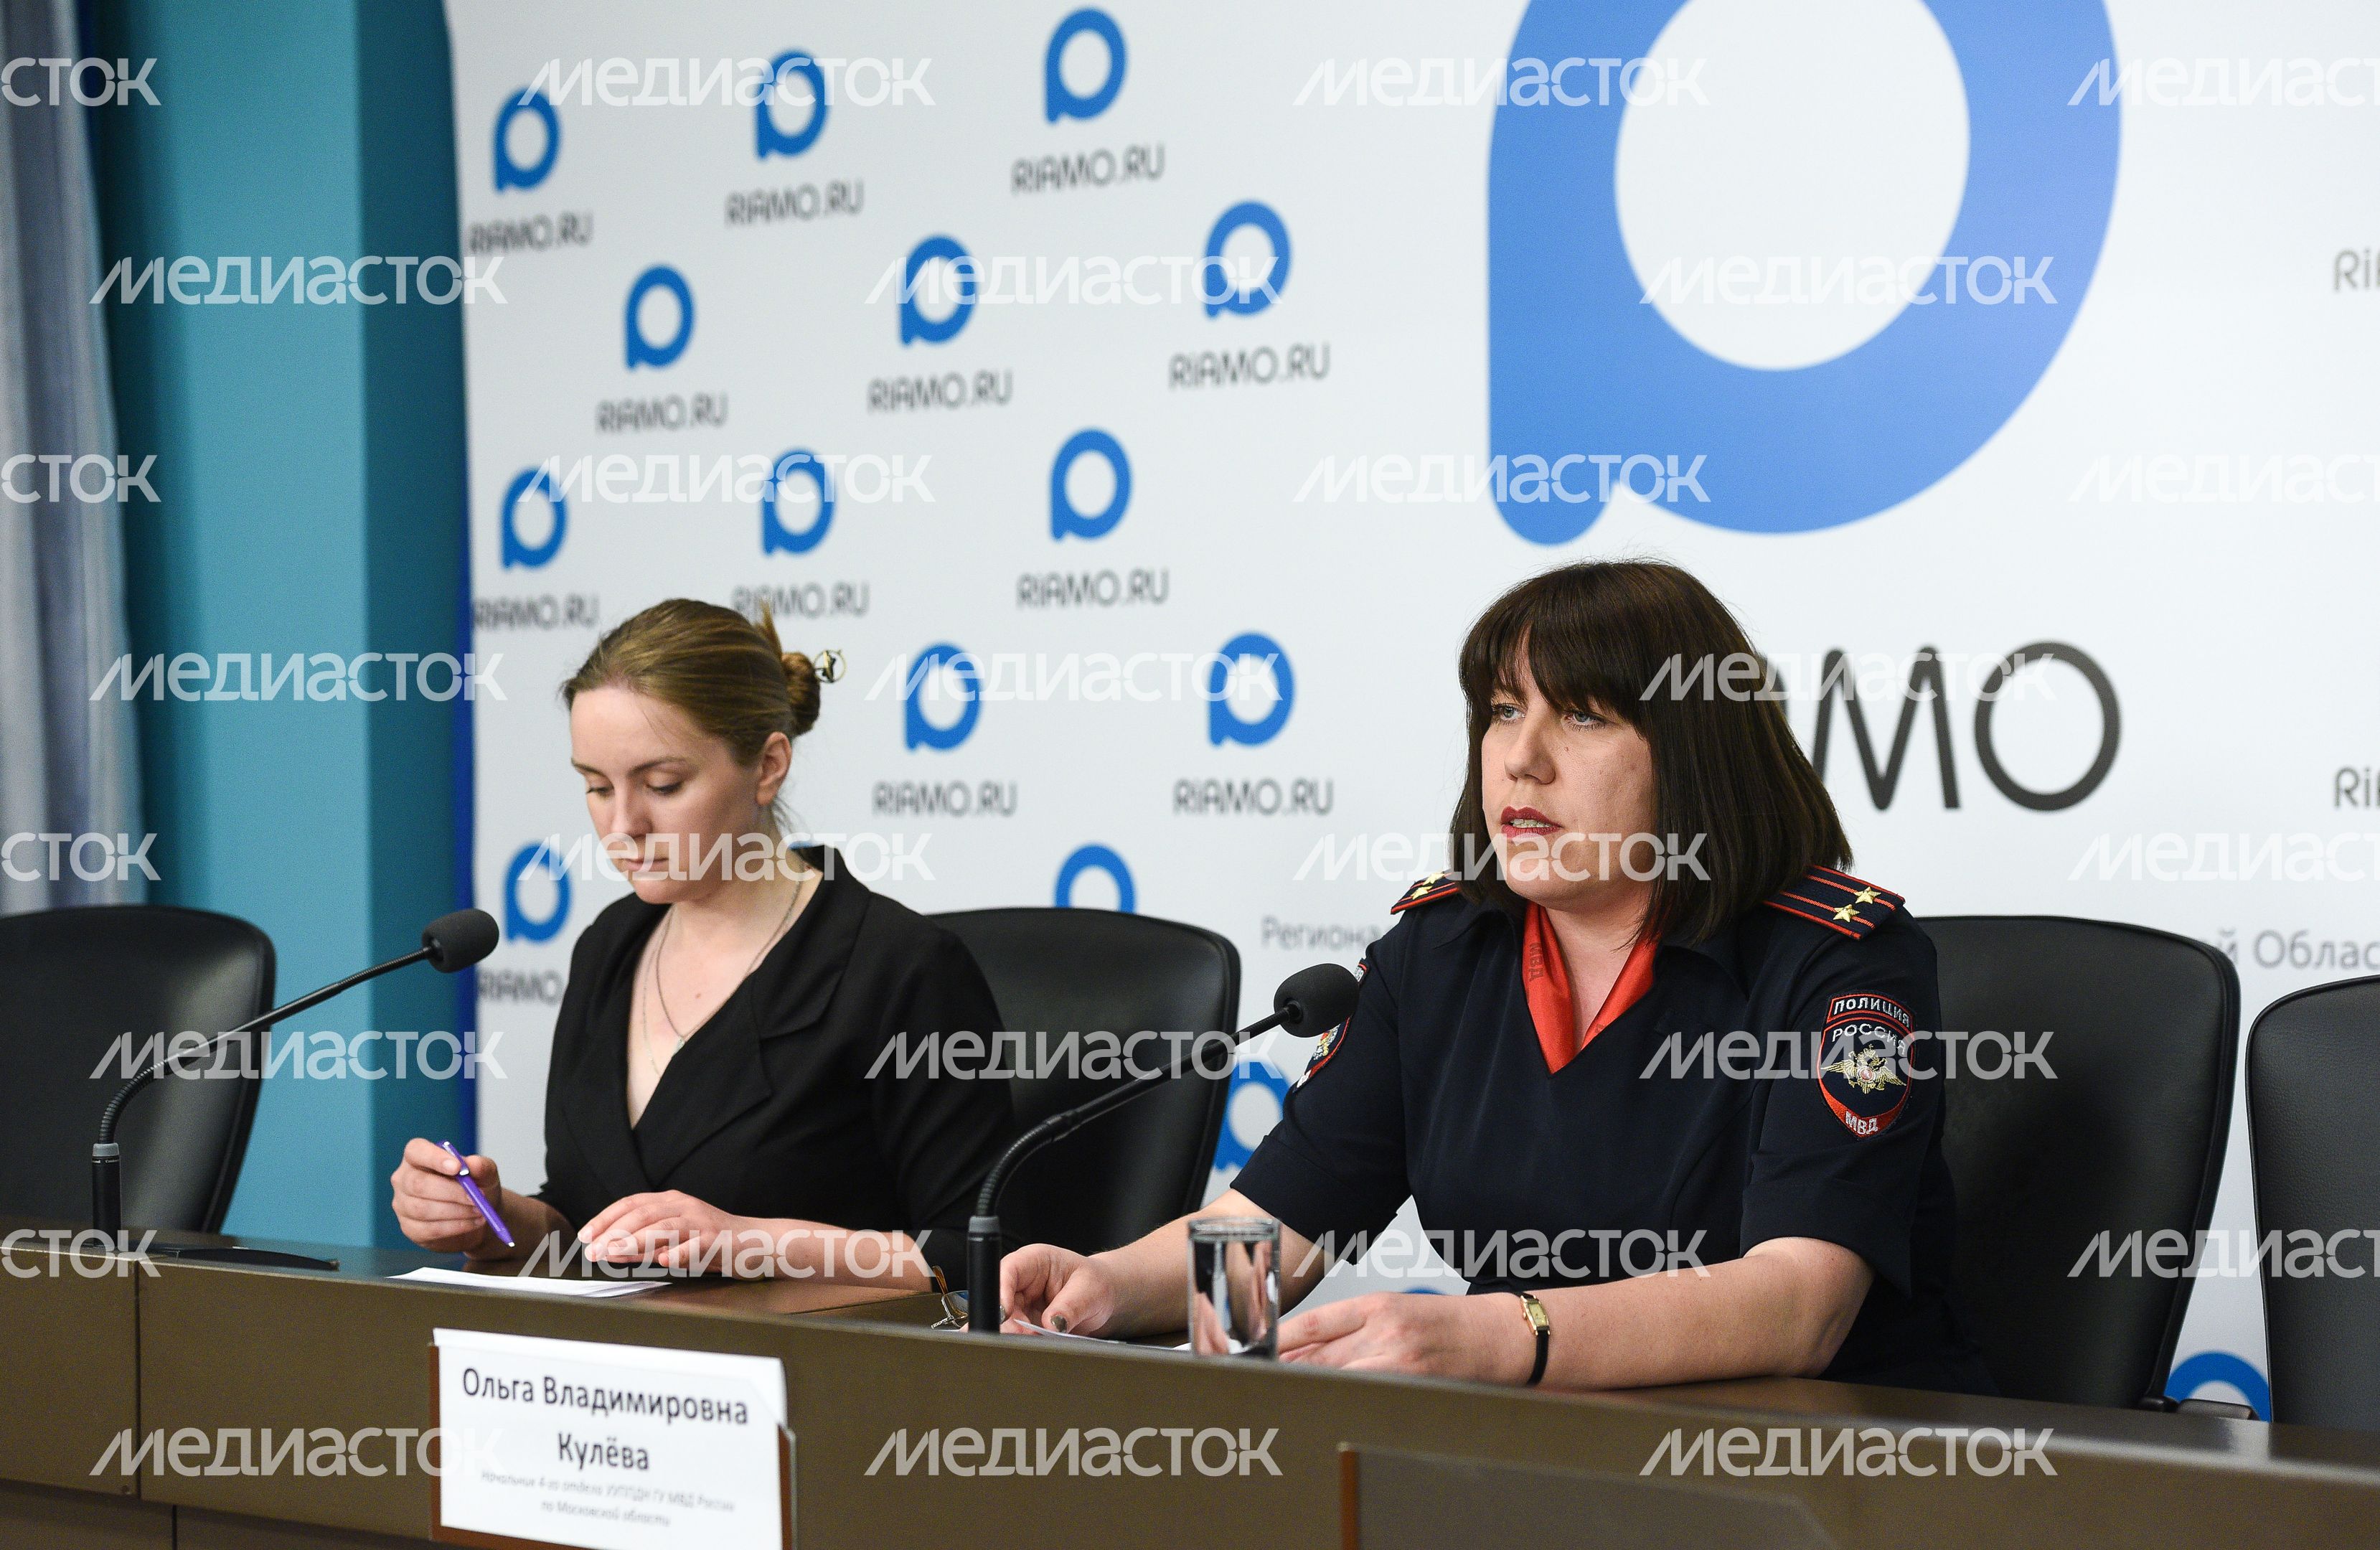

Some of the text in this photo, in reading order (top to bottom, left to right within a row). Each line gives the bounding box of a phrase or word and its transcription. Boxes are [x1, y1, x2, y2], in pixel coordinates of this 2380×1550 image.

[1833, 996, 1911, 1028] ПОЛИЦИЯ
[1831, 1023, 1906, 1056] РОССИЯ
[1845, 1110, 1878, 1135] МВД
[462, 1367, 748, 1424] Ольга Владимировна
[558, 1432, 650, 1471] Кулёва
